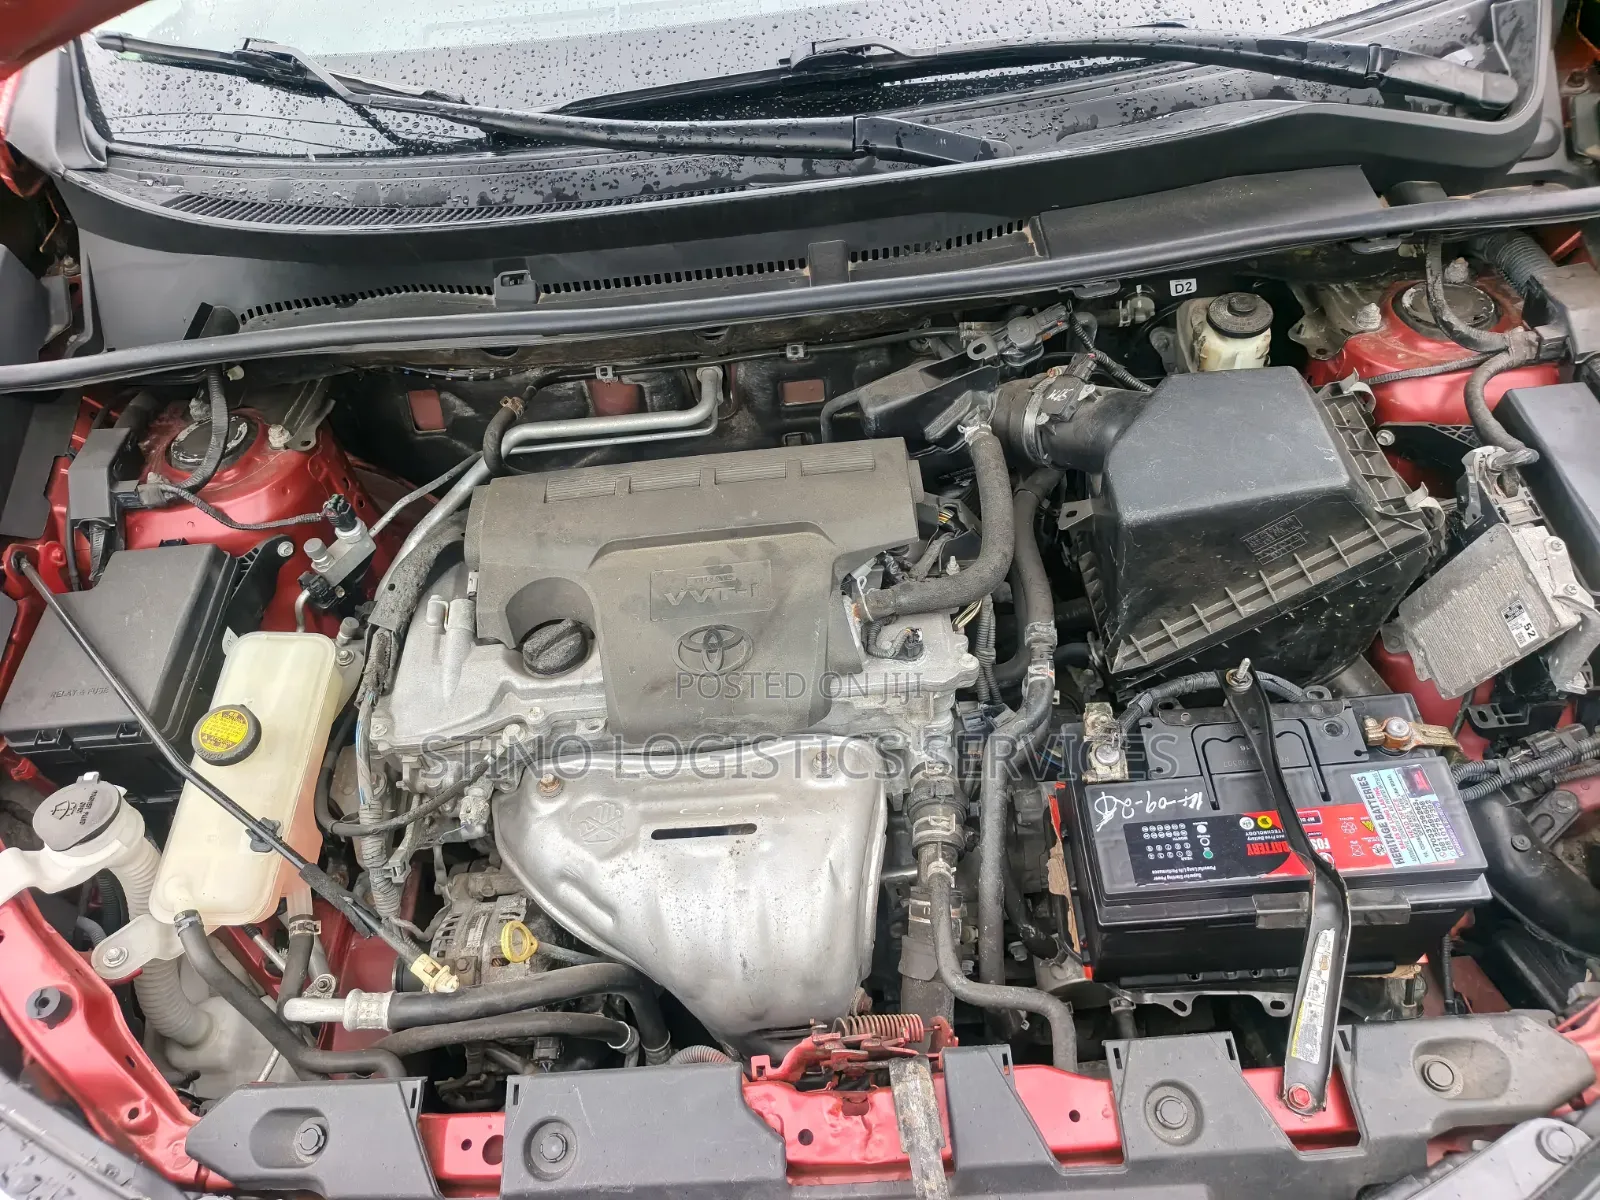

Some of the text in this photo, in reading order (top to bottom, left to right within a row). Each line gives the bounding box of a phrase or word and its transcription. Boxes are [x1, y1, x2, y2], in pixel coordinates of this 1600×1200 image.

[1174, 280, 1194, 295] D2
[1523, 622, 1536, 639] 52
[50, 689, 78, 698] RELAY
[87, 687, 109, 695] FUSE
[1356, 775, 1385, 820] BATTERIES
[1372, 787, 1386, 808] LASTING
[1383, 809, 1394, 824] LONG
[1402, 820, 1415, 838] HEAD
[1246, 840, 1290, 856] BATTERY
[1310, 838, 1331, 850] FOS
[1377, 822, 1405, 864] HERITAGE
[1393, 832, 1406, 849] SALES
